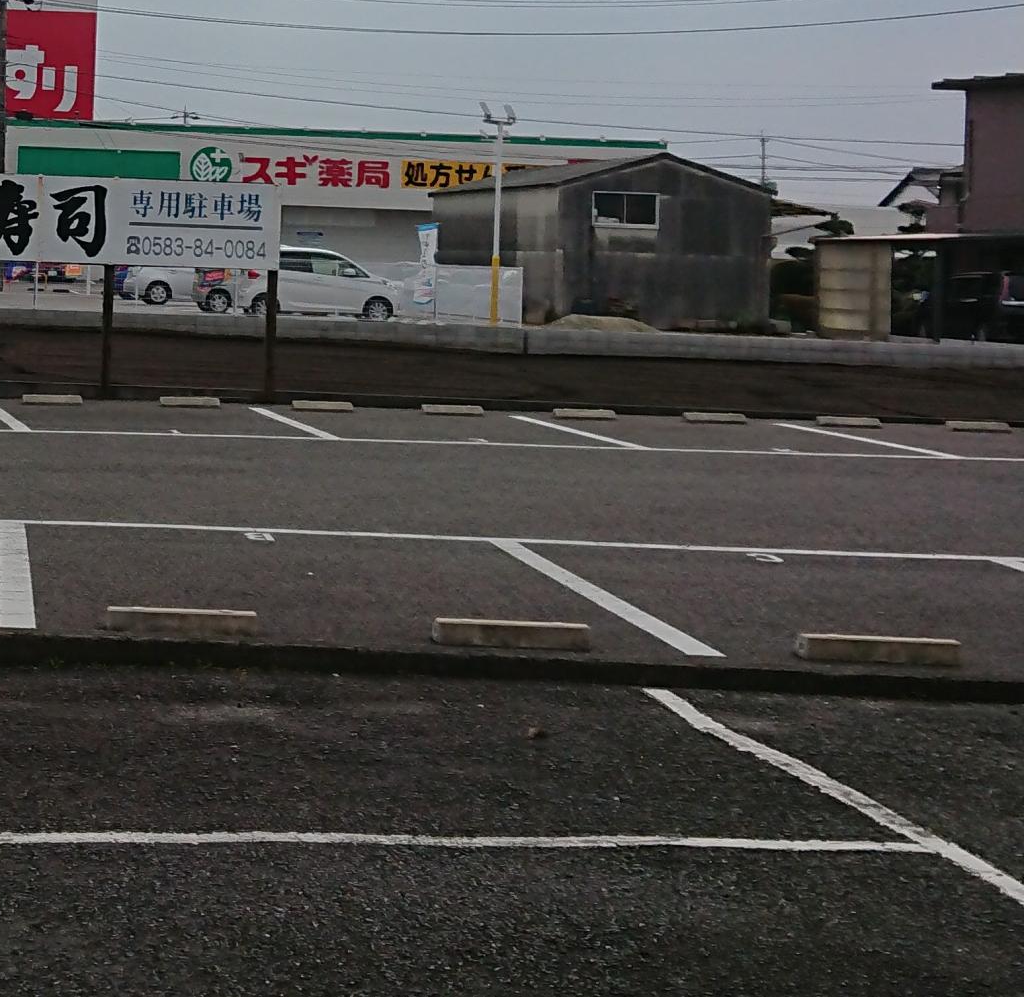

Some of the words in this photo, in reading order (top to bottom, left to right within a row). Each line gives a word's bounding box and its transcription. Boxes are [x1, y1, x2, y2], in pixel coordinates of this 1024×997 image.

[242, 154, 389, 188] スギ薬局
[129, 190, 263, 222] 専用駐車場
[141, 236, 267, 260] 0583-84-0084
